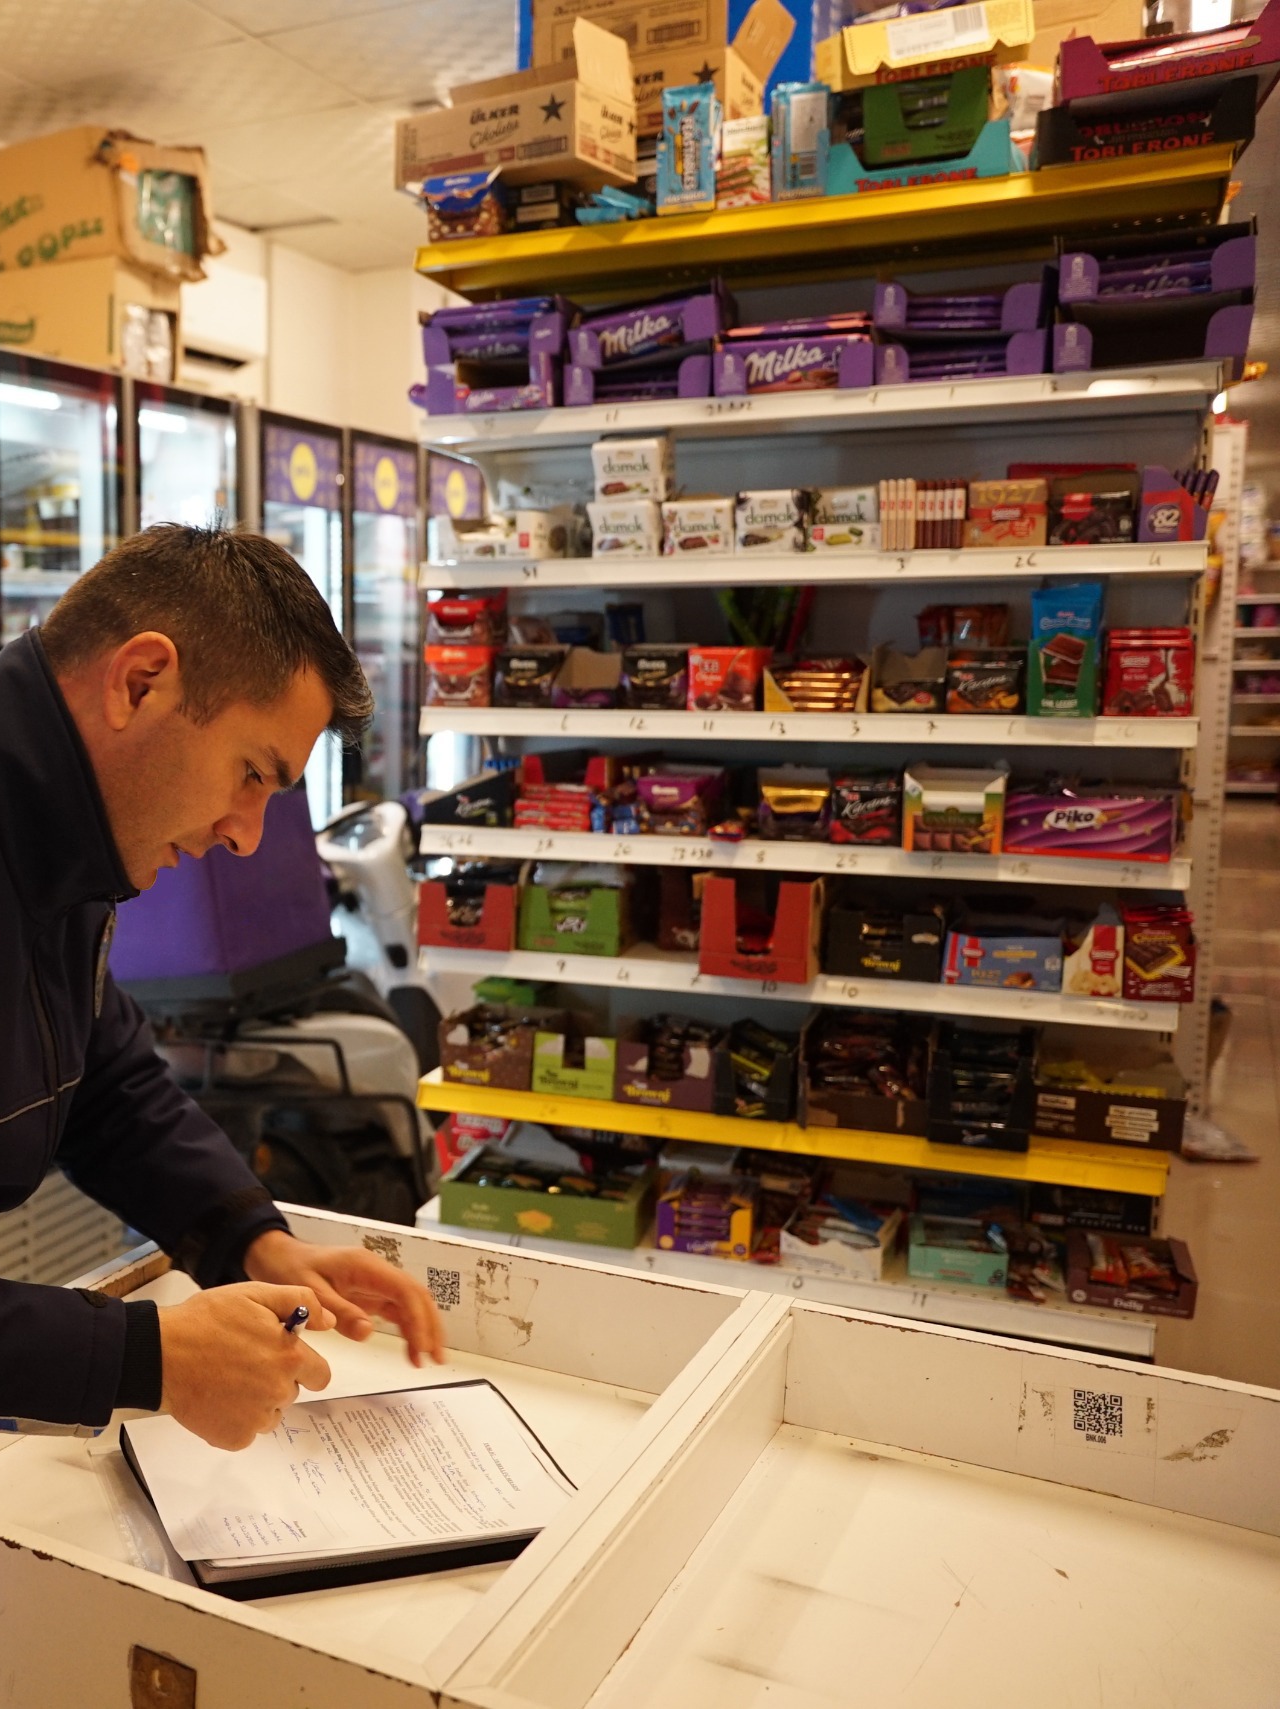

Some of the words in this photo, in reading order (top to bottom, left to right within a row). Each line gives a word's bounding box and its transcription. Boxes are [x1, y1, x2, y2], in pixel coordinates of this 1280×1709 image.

[1097, 53, 1255, 93] TOBLERONE
[1071, 131, 1216, 162] TOBLERONE
[599, 313, 671, 356] Milka
[745, 342, 824, 385] Milka
[603, 456, 650, 474] damak
[599, 515, 644, 533] damak
[1054, 810, 1095, 824] Piko
[835, 853, 859, 868] 25
[841, 981, 860, 998] 10
